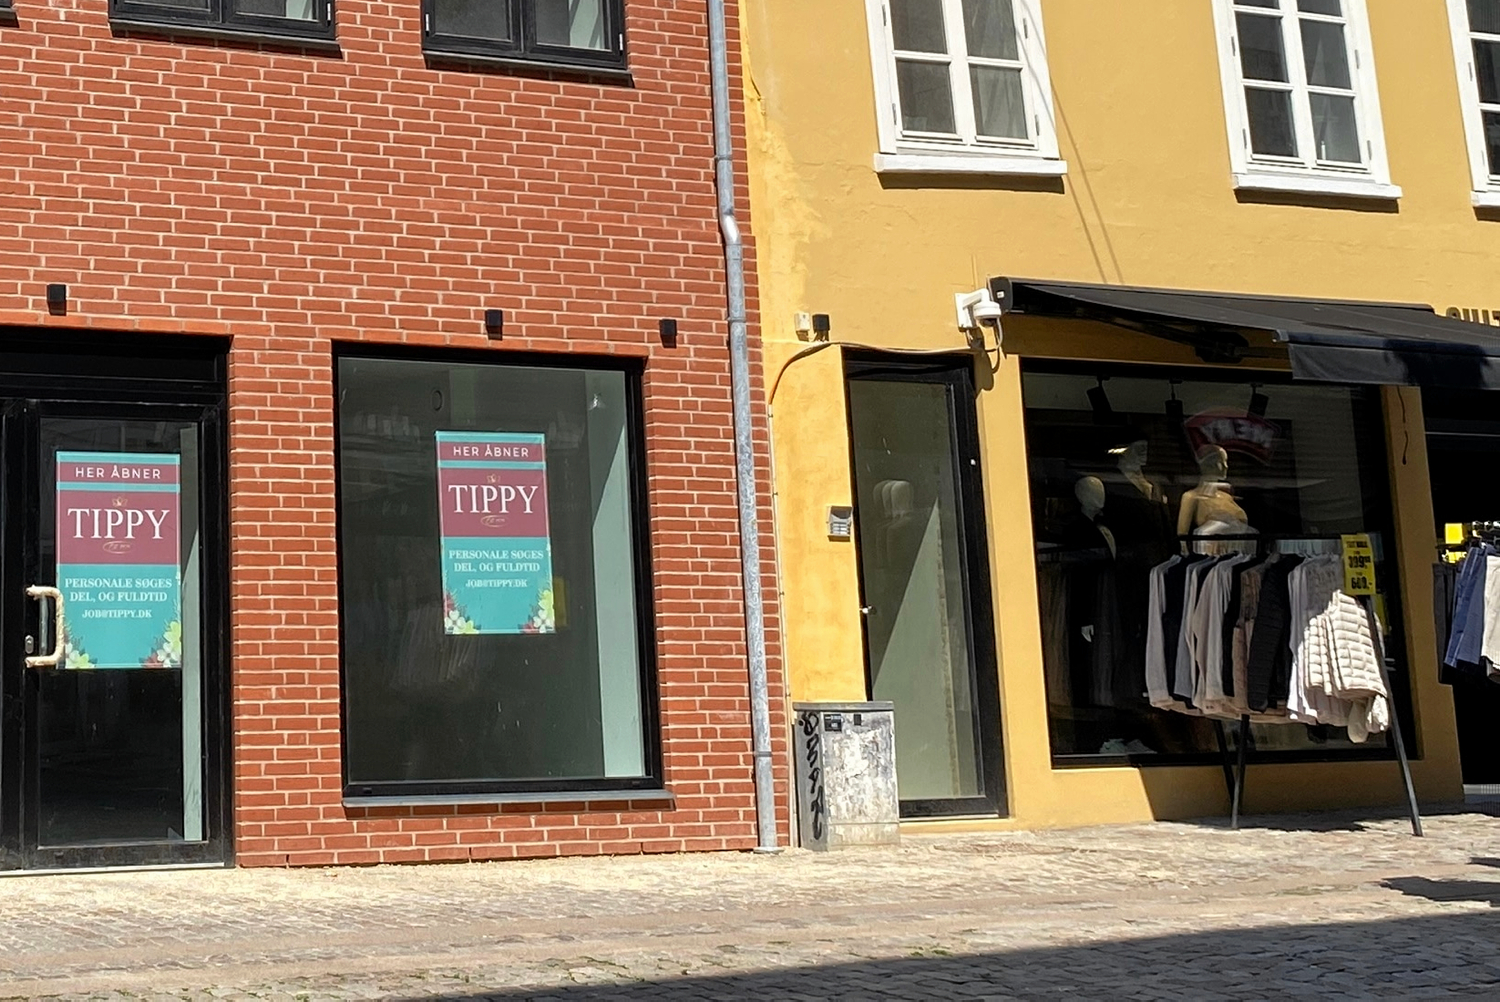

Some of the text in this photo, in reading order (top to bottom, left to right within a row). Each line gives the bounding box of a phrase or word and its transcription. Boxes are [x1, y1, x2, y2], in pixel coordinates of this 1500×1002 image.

[453, 443, 529, 458] HER ÅBNER
[75, 464, 161, 480] HER ÅBNER
[448, 484, 539, 514] TIPPY
[67, 508, 170, 539] TIPPY
[448, 549, 509, 560] PERSONALE
[453, 562, 540, 573] DEL, OG FULDTID
[64, 577, 173, 588] PERSONALE SØGES
[69, 591, 168, 603] DEL, OG FULDTID
